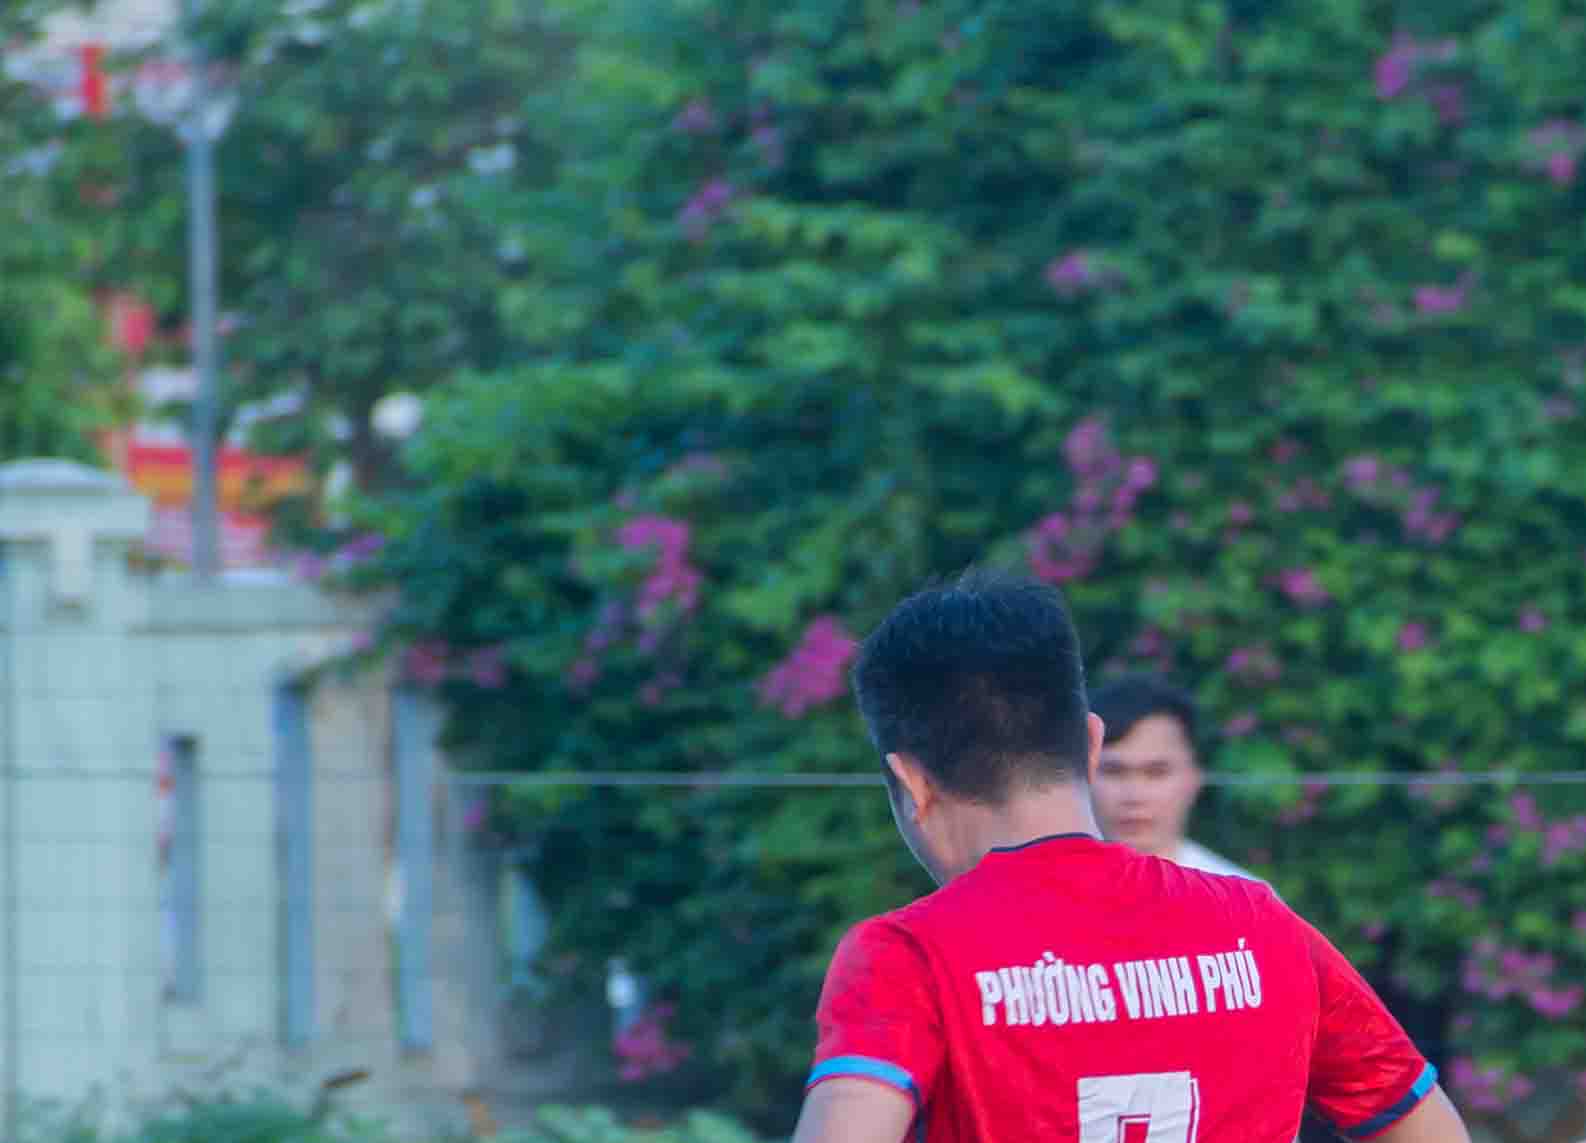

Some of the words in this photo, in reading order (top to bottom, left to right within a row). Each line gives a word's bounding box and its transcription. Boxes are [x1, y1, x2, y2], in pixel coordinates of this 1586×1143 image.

[975, 950, 1117, 1026] PHƯỜNG
[1113, 956, 1199, 1019] VINH
[1196, 937, 1263, 1013] PHÚ
